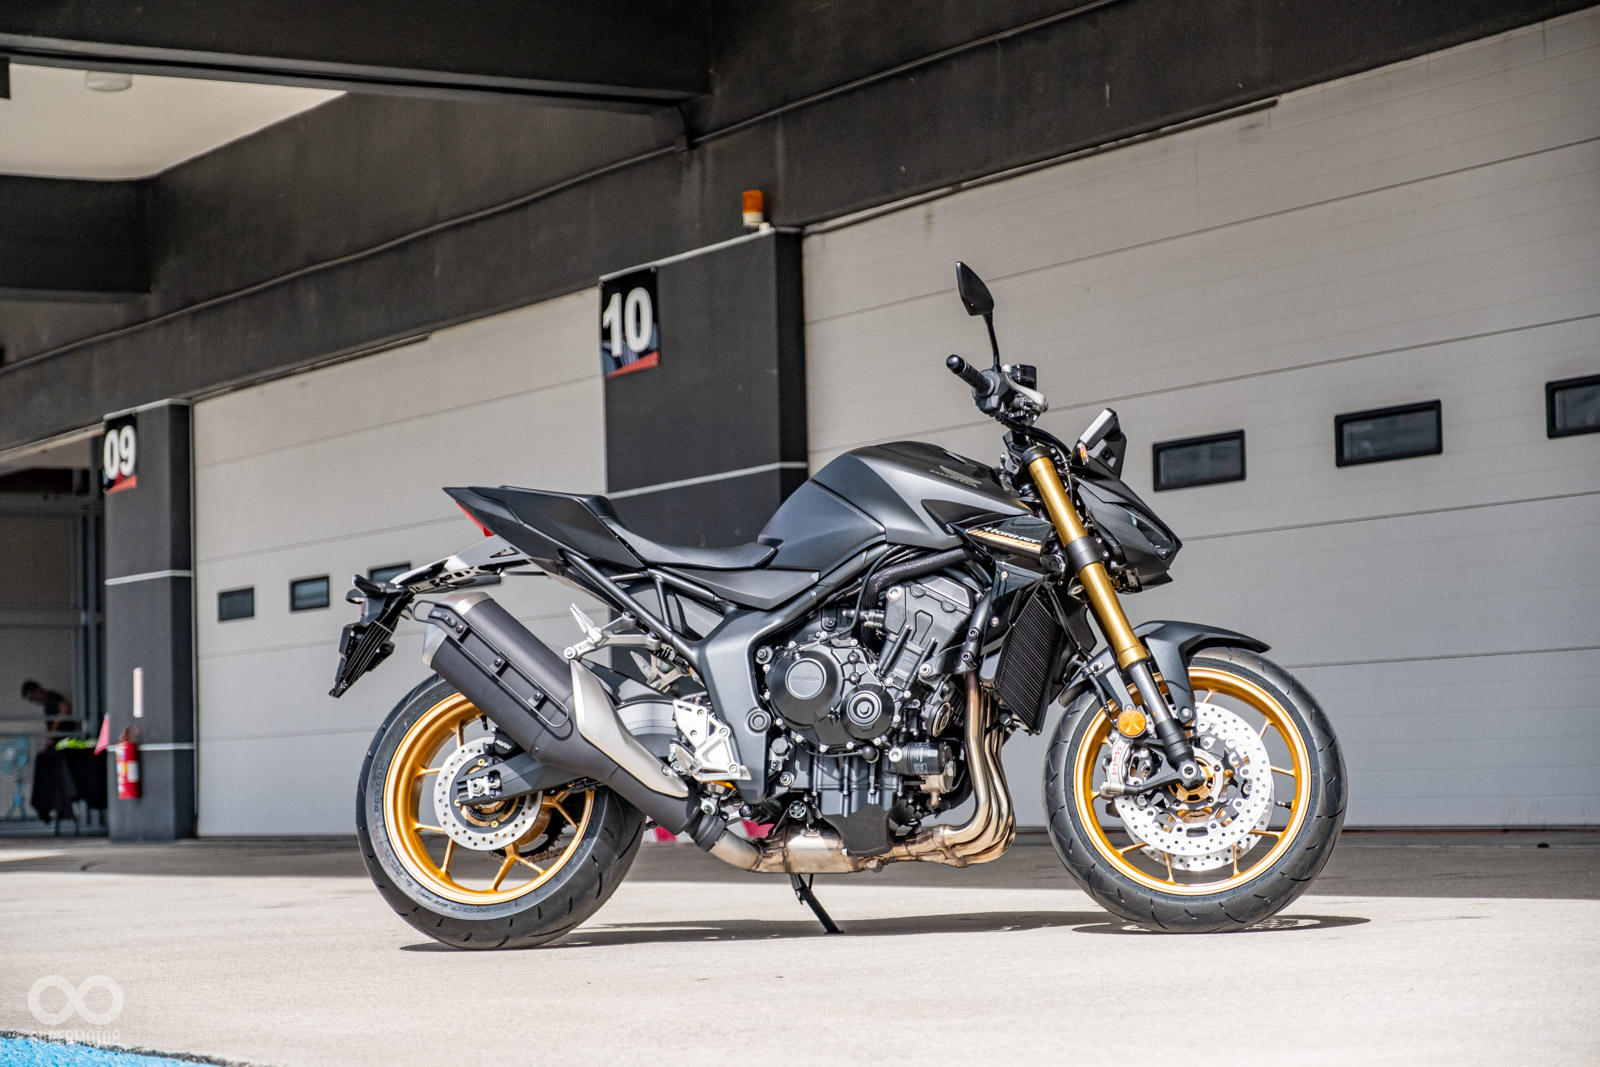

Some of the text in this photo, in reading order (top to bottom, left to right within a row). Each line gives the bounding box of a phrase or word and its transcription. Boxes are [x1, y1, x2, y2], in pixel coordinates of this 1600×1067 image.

[603, 287, 653, 357] 10
[104, 425, 136, 480] 09
[1111, 745, 1123, 776] brembo
